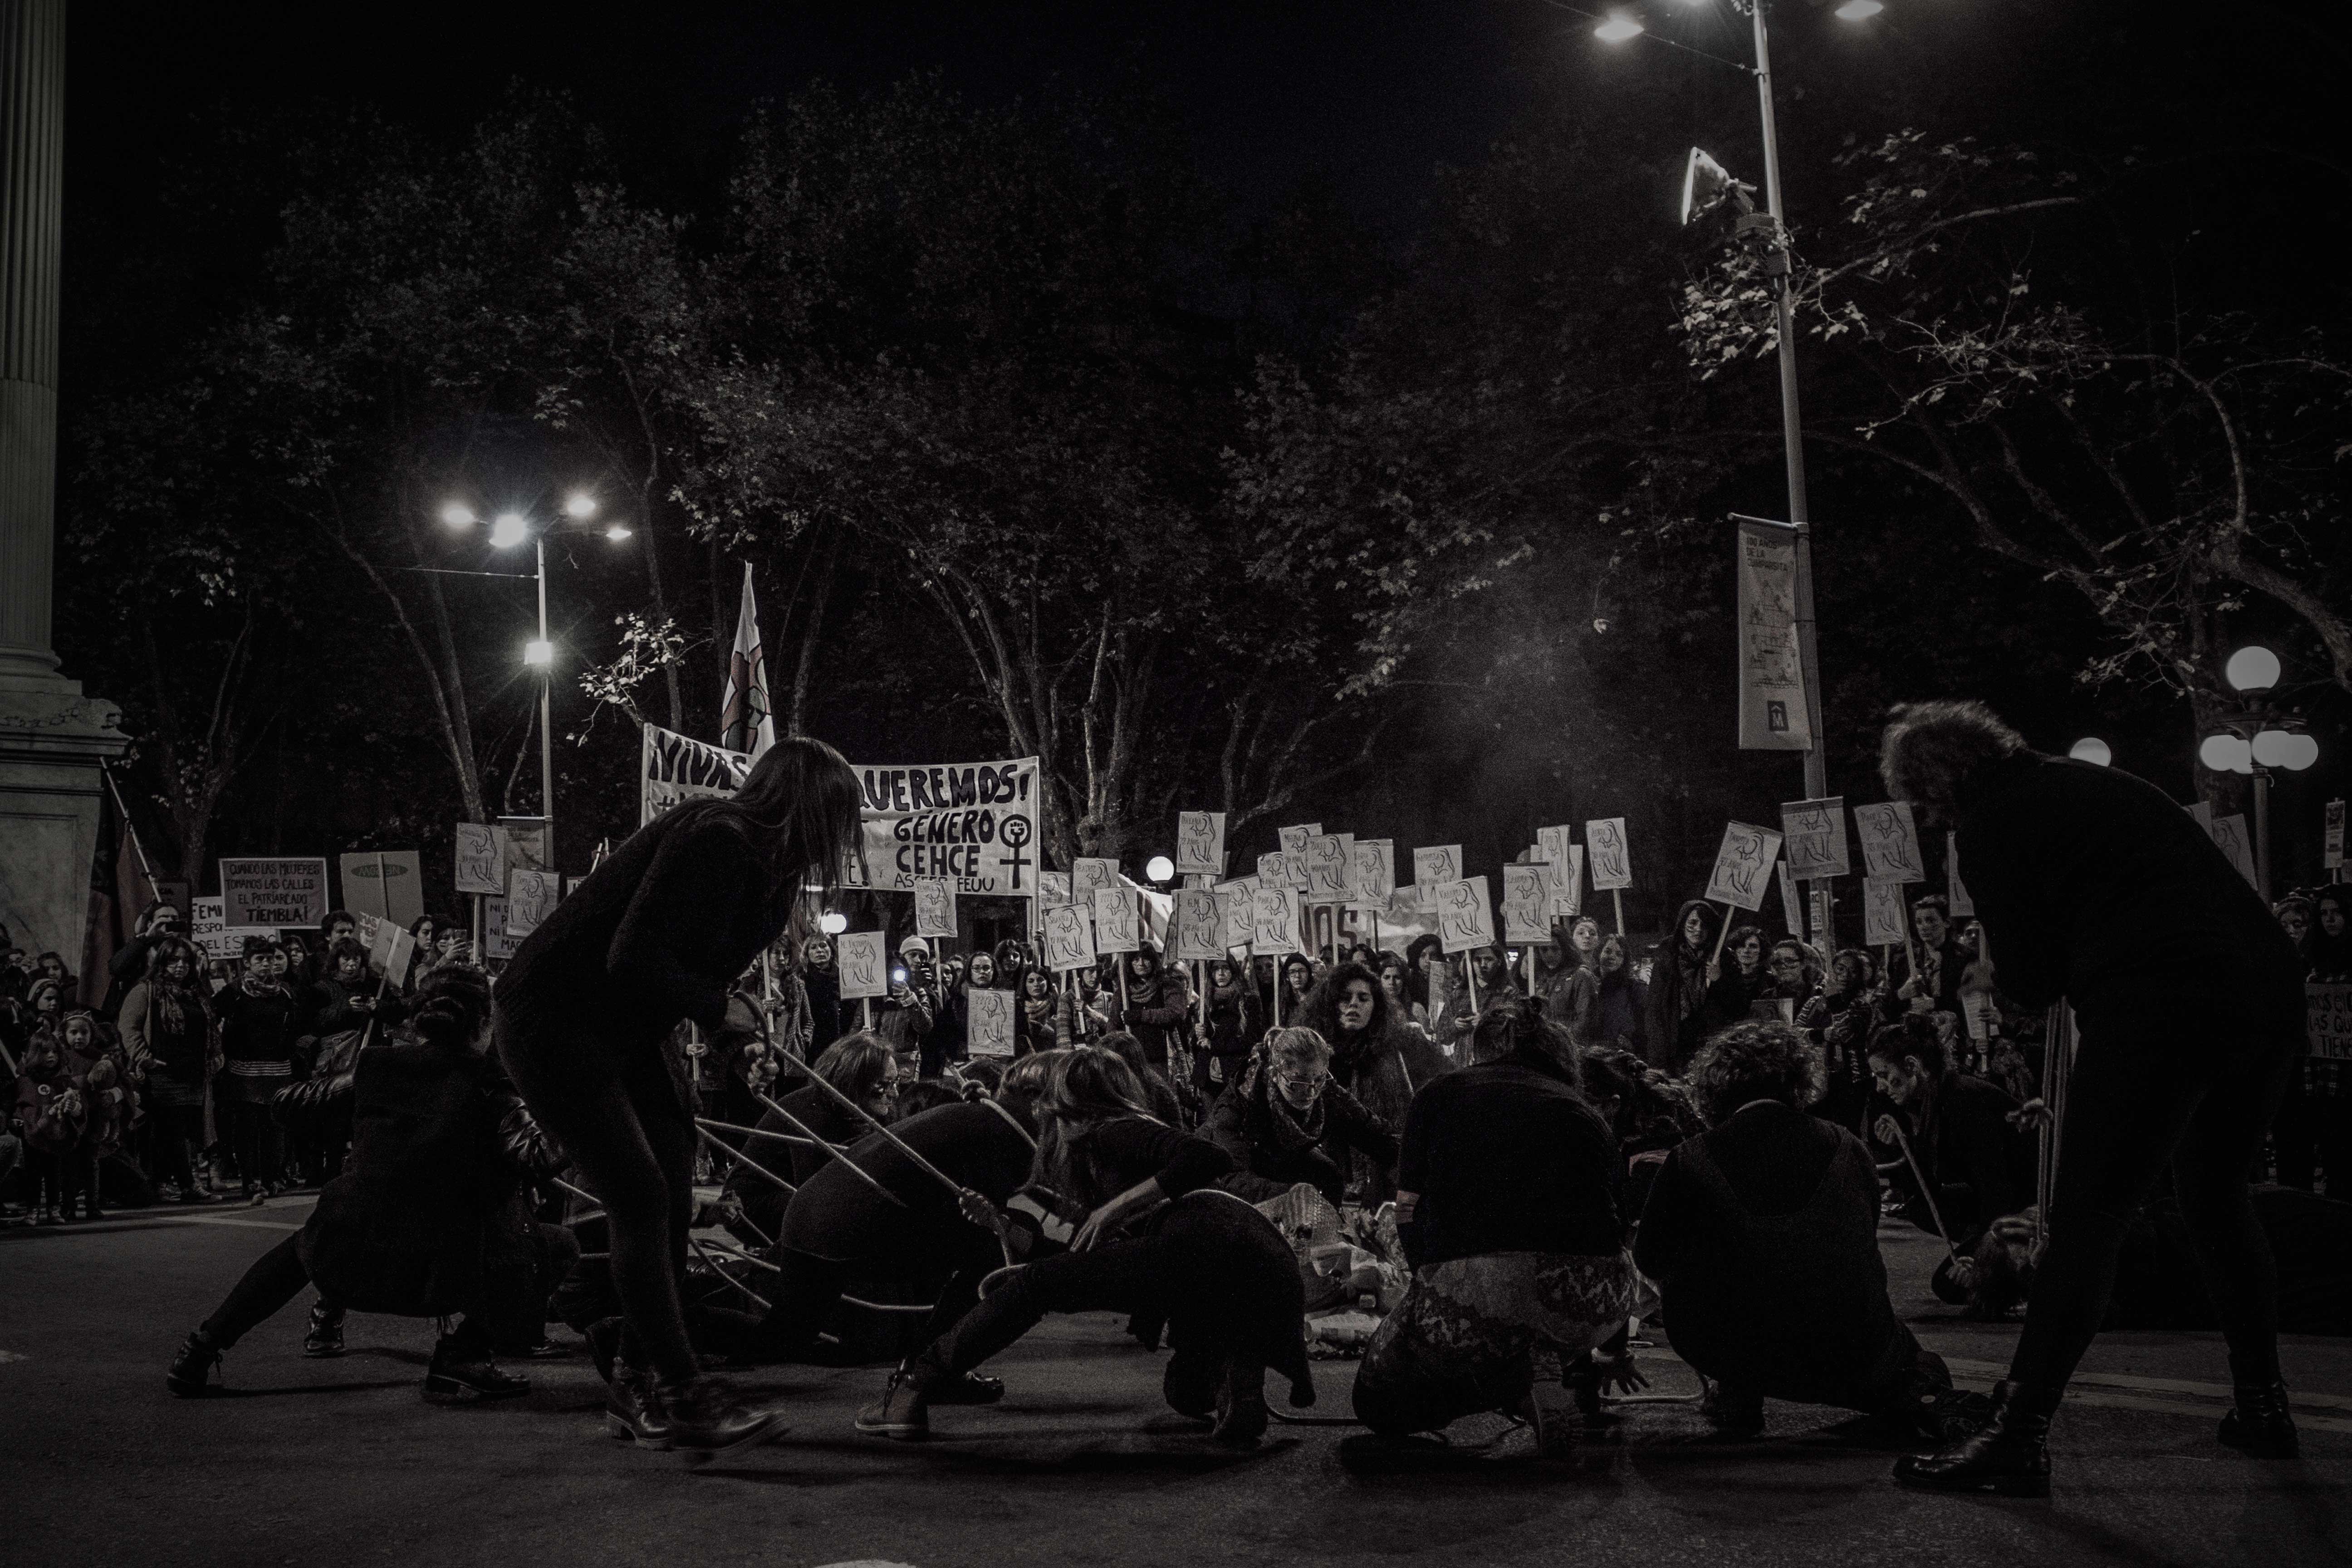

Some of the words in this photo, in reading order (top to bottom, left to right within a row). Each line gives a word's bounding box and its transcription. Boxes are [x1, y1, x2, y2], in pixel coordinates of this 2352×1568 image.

[861, 764, 1029, 811] UEREMOS!
[893, 809, 995, 843] GÉNERO
[896, 845, 980, 876] CEHCE
[261, 863, 276, 875] LAS
[279, 864, 319, 875] MUJERES
[265, 879, 279, 889] LAS
[282, 879, 314, 890] CALLES
[957, 877, 995, 892] FEUU
[238, 894, 249, 904] EL
